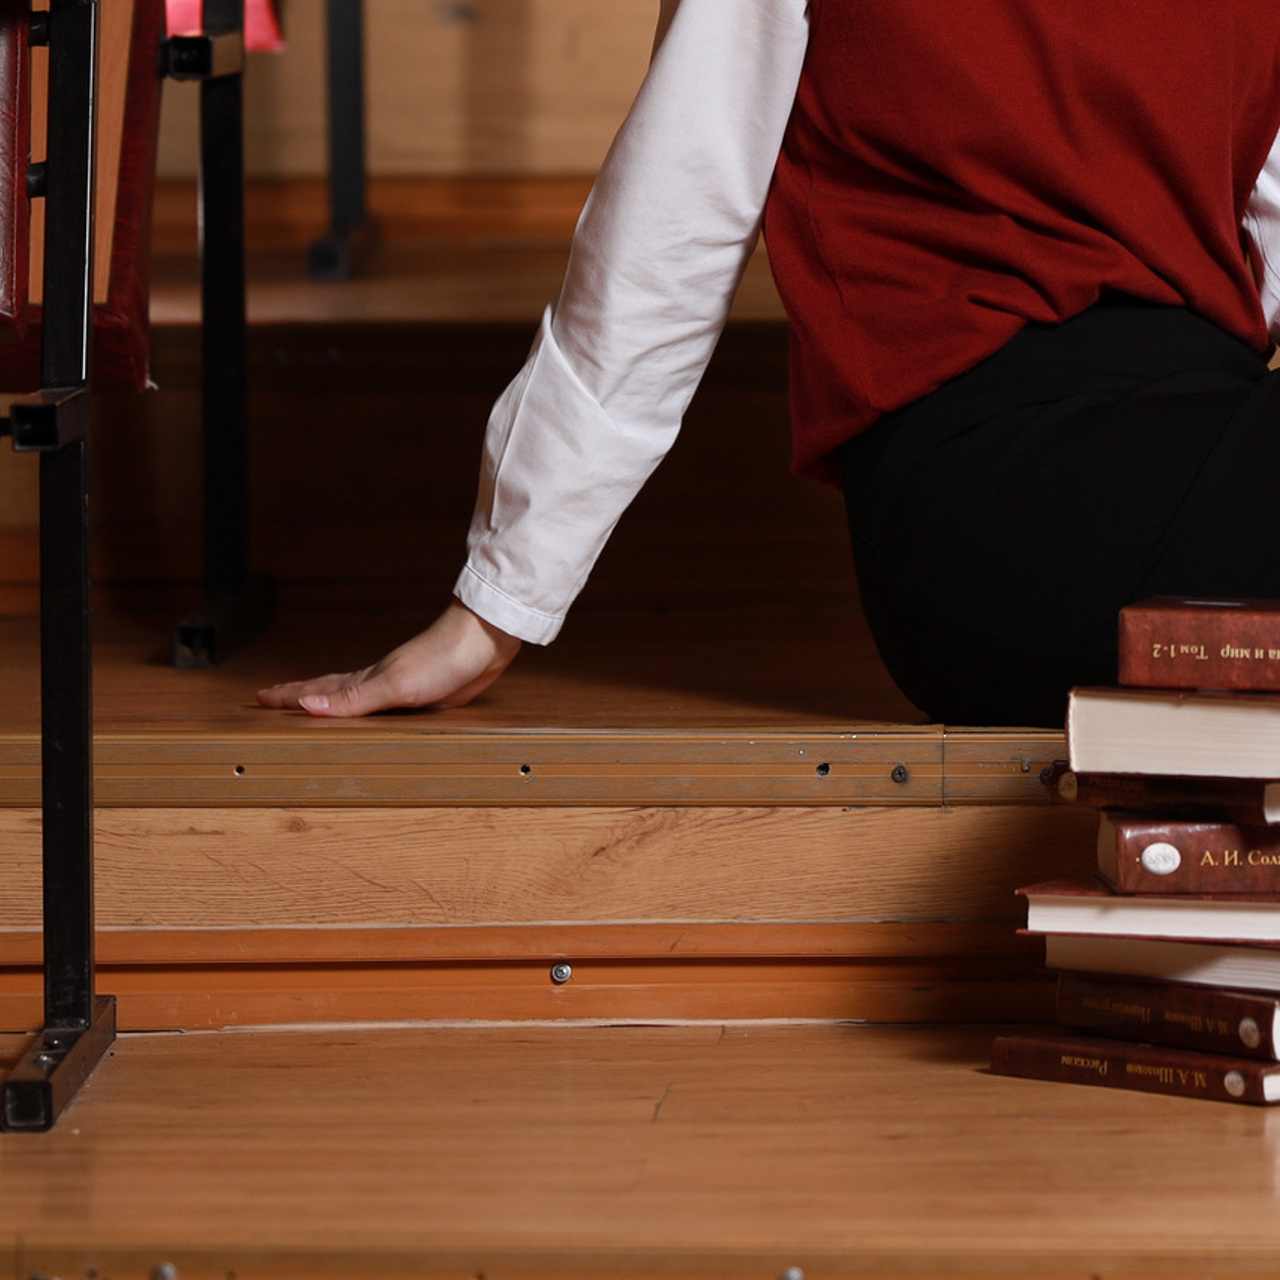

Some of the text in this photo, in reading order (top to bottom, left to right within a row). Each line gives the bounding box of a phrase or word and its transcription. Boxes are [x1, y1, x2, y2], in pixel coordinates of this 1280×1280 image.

[1153, 643, 1175, 658] 1-2
[1180, 645, 1209, 660] Том
[1220, 644, 1250, 659] мир
[1254, 648, 1264, 659] и
[1200, 850, 1218, 866] А.
[1223, 850, 1243, 866] И.
